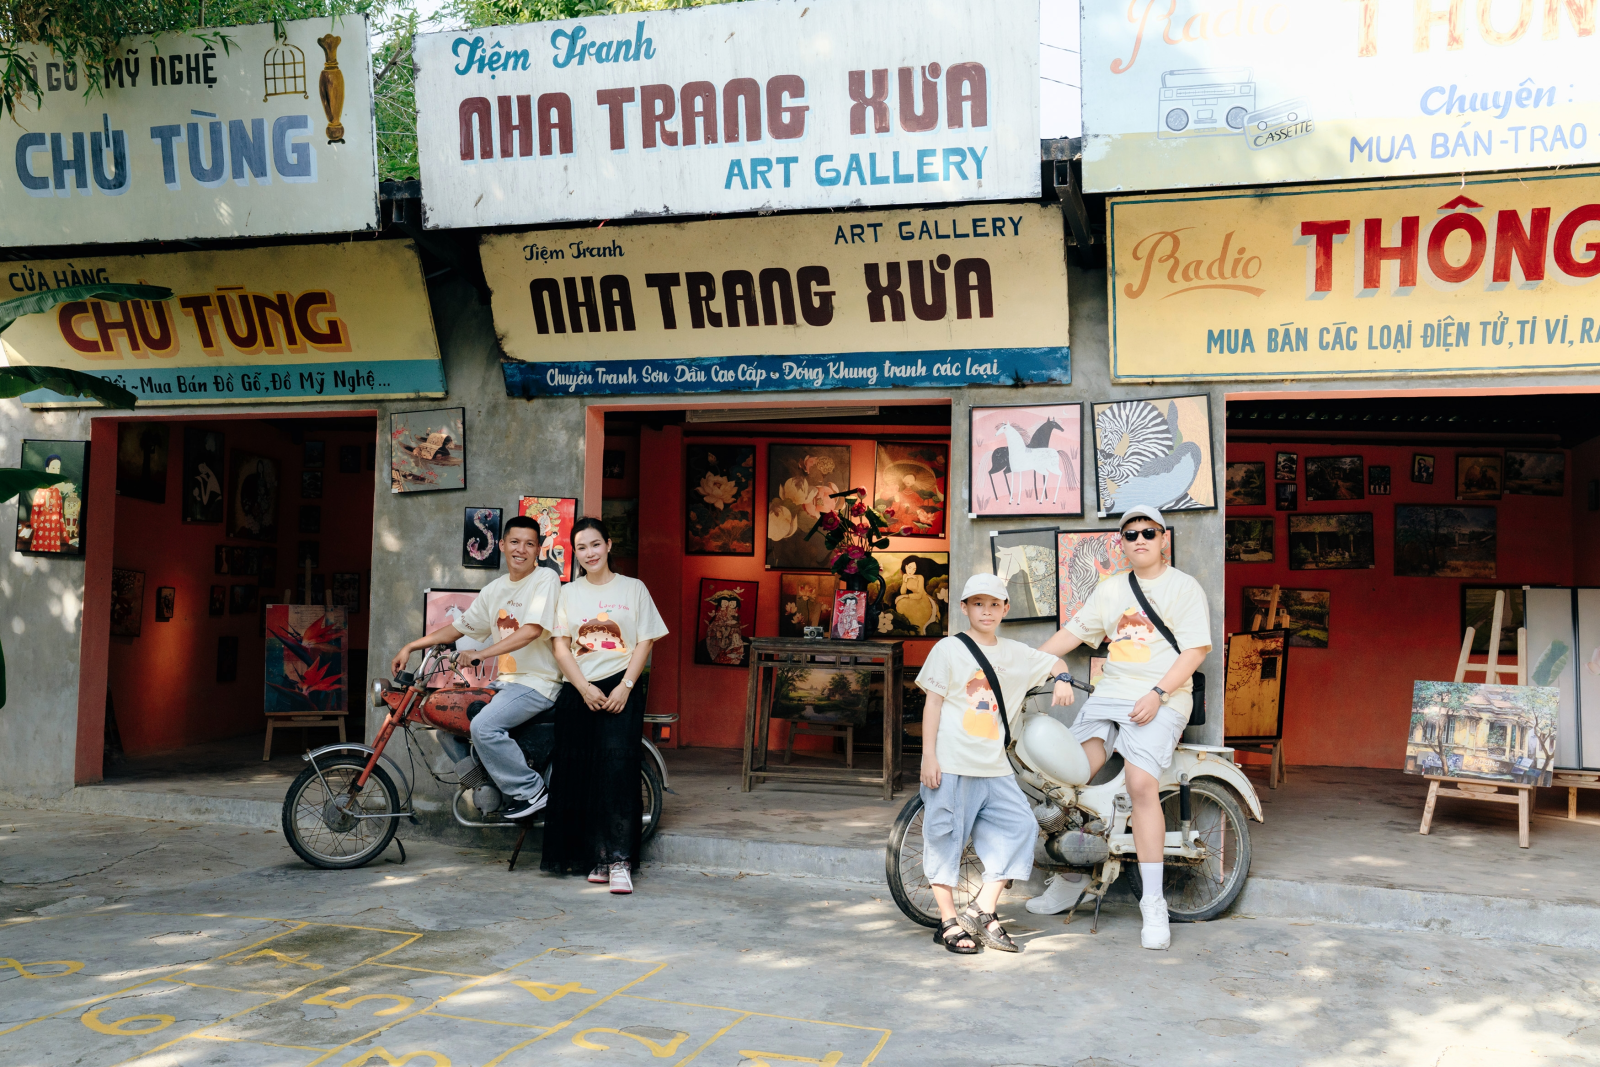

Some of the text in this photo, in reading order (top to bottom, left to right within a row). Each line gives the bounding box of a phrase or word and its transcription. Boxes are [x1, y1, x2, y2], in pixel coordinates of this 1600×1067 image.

[150, 45, 218, 88] NGHỆ
[452, 20, 656, 80] Tiệm Tranh
[459, 61, 989, 162] NHA TRANG XƯA
[150, 109, 317, 190] TÙNG
[1254, 120, 1312, 147] CASSETTE
[1350, 133, 1417, 163] MUA
[725, 146, 989, 190] ART GALLERY
[834, 216, 1024, 245] ART GALLERY
[1296, 195, 1600, 298] THÔNG
[522, 239, 625, 264] Tiệm Tranh
[1123, 226, 1263, 300] Radio
[9, 262, 110, 292] CỬA HÀNG
[529, 253, 996, 335] NHA TRANG XƯA
[1206, 328, 1256, 354] MUA
[1267, 321, 1308, 353] BÁN
[1318, 321, 1359, 351] CÁC
[176, 375, 208, 393] Bán
[213, 372, 234, 392] Đồ
[299, 371, 326, 394] Mỹ
[546, 368, 594, 393] Chuyên
[595, 366, 639, 385] Tranh
[641, 365, 671, 384] Sơn
[673, 364, 707, 383] Dầu
[711, 365, 736, 383] Cao
[737, 362, 768, 388] Cấp
[826, 360, 879, 385] Khung
[883, 358, 929, 378] tranh
[932, 357, 961, 377] các
[965, 356, 1001, 379] loại
